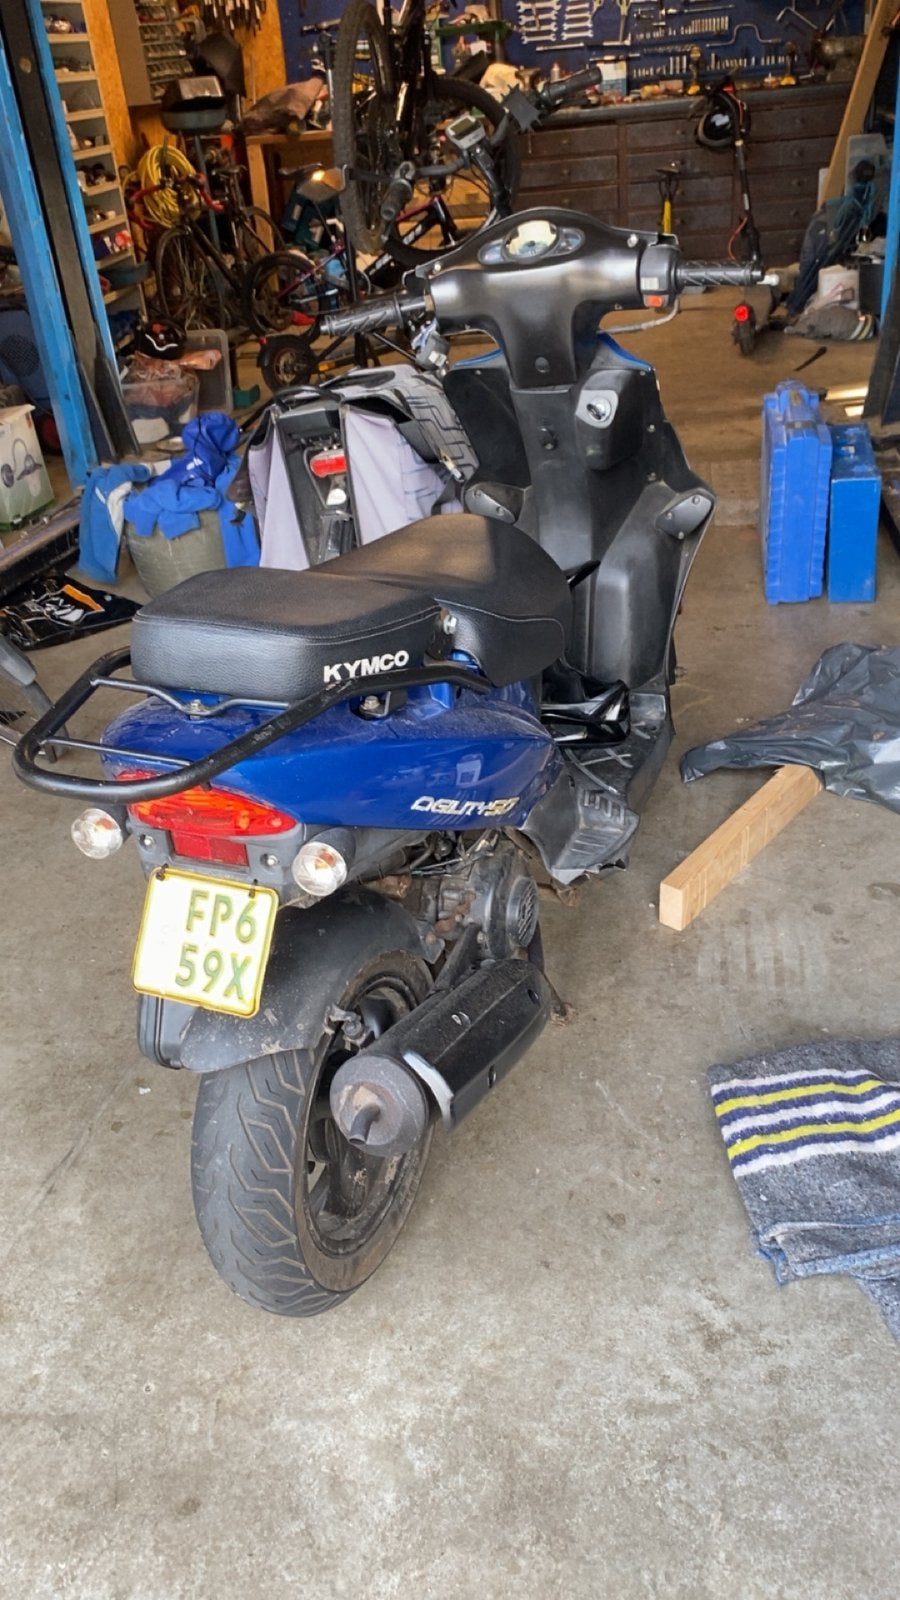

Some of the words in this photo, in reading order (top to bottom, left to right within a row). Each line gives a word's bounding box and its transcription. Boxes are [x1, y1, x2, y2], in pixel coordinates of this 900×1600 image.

[323, 650, 410, 683] KYMCO
[185, 888, 258, 944] FP6
[175, 942, 253, 1001] 59X
